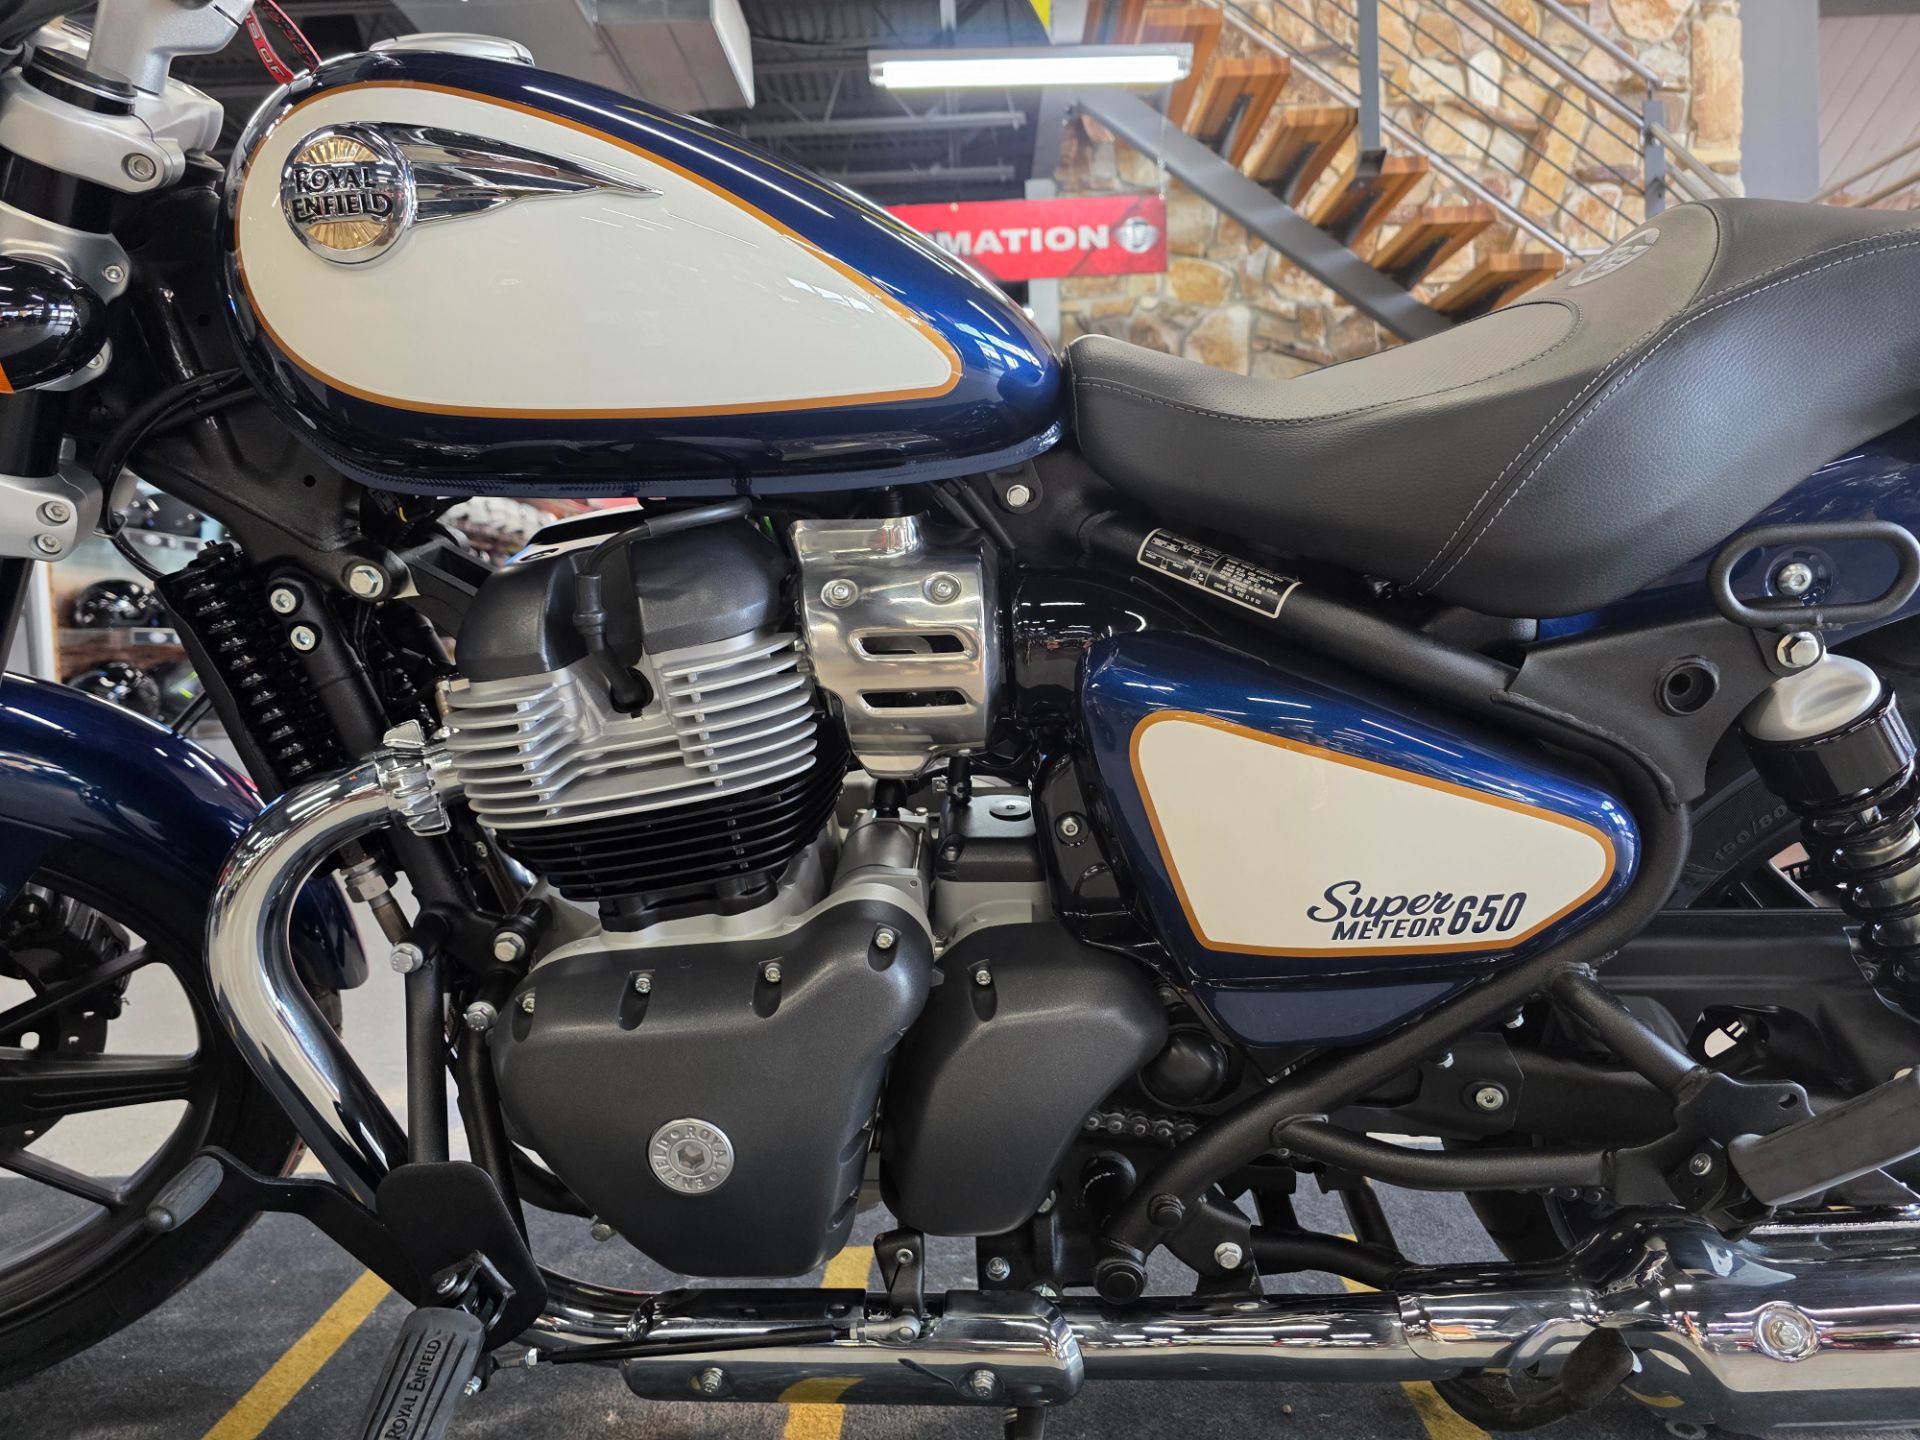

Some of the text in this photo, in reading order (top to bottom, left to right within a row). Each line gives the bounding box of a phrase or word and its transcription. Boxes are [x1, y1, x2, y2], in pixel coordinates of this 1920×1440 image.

[294, 166, 377, 194] ROYAL
[291, 193, 394, 223] ENFIELD
[1306, 880, 1456, 929] Super
[1331, 892, 1528, 941] METEOR 650
[684, 1125, 727, 1170] ROYAL
[385, 1339, 442, 1440] ROYAL ENFIELD
